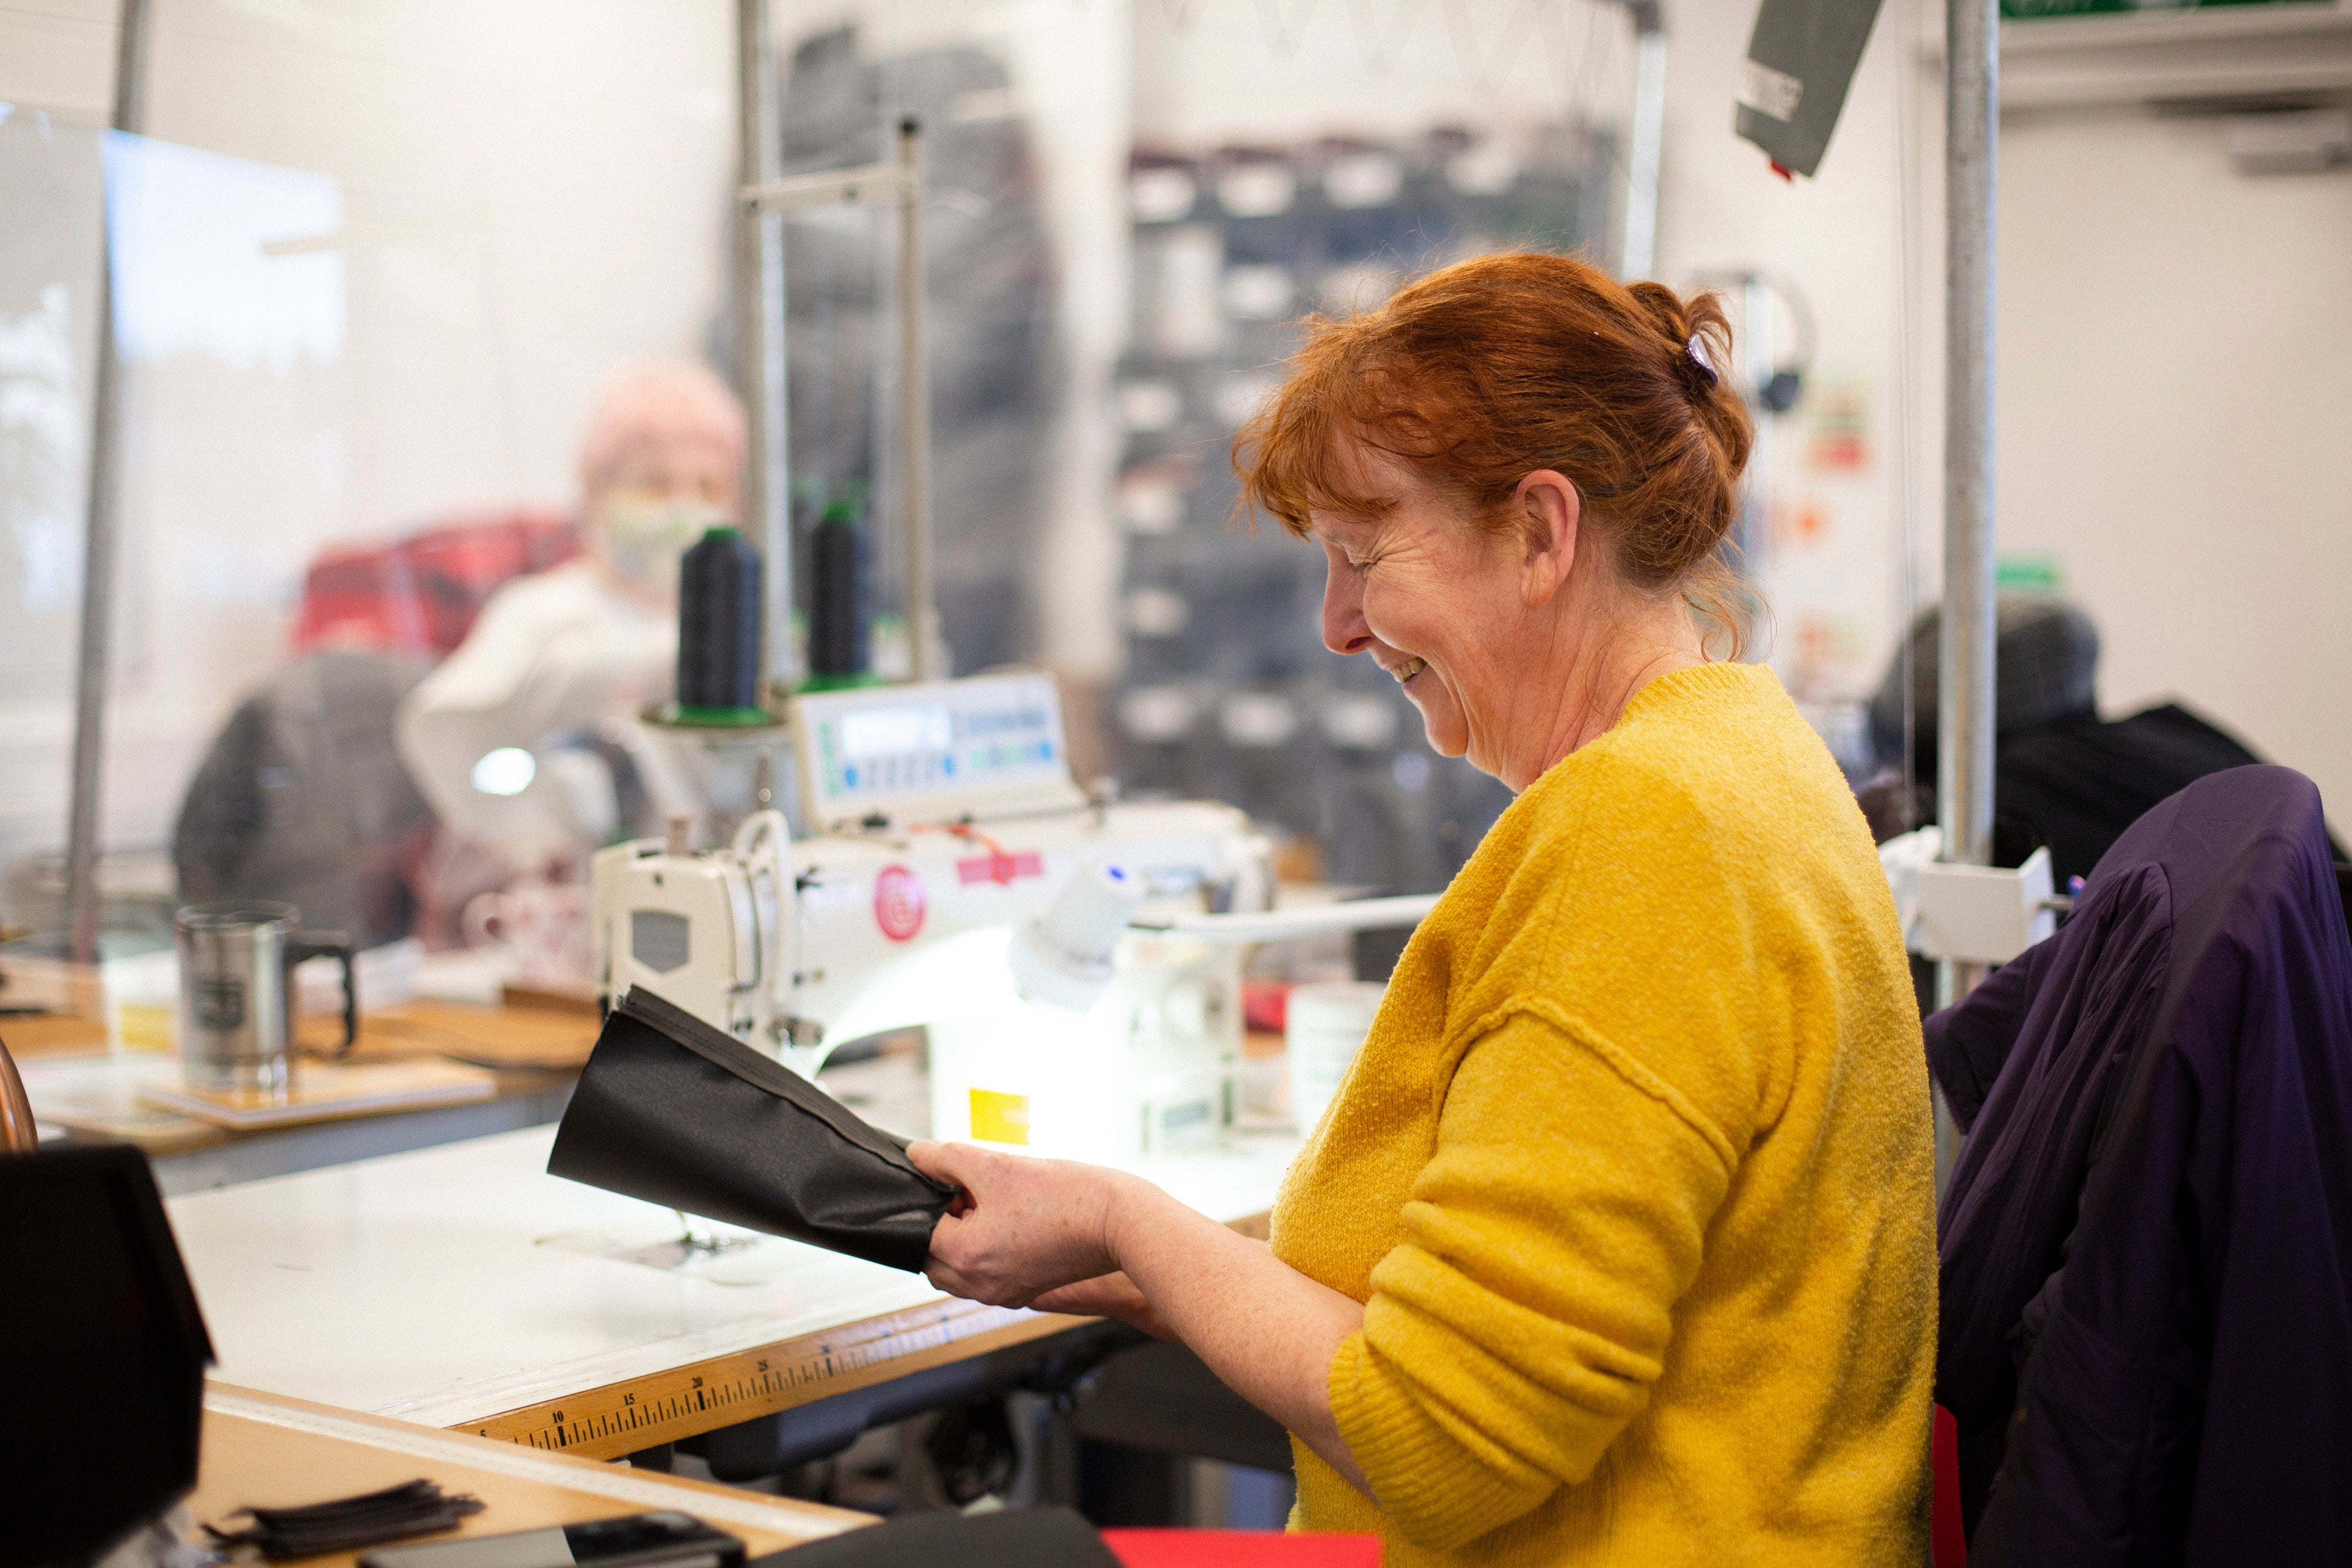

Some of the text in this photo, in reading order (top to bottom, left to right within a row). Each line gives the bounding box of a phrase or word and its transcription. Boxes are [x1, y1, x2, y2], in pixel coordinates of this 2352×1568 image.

[552, 1410, 564, 1424] 10
[623, 1393, 635, 1406] 15
[691, 1376, 703, 1389] 20
